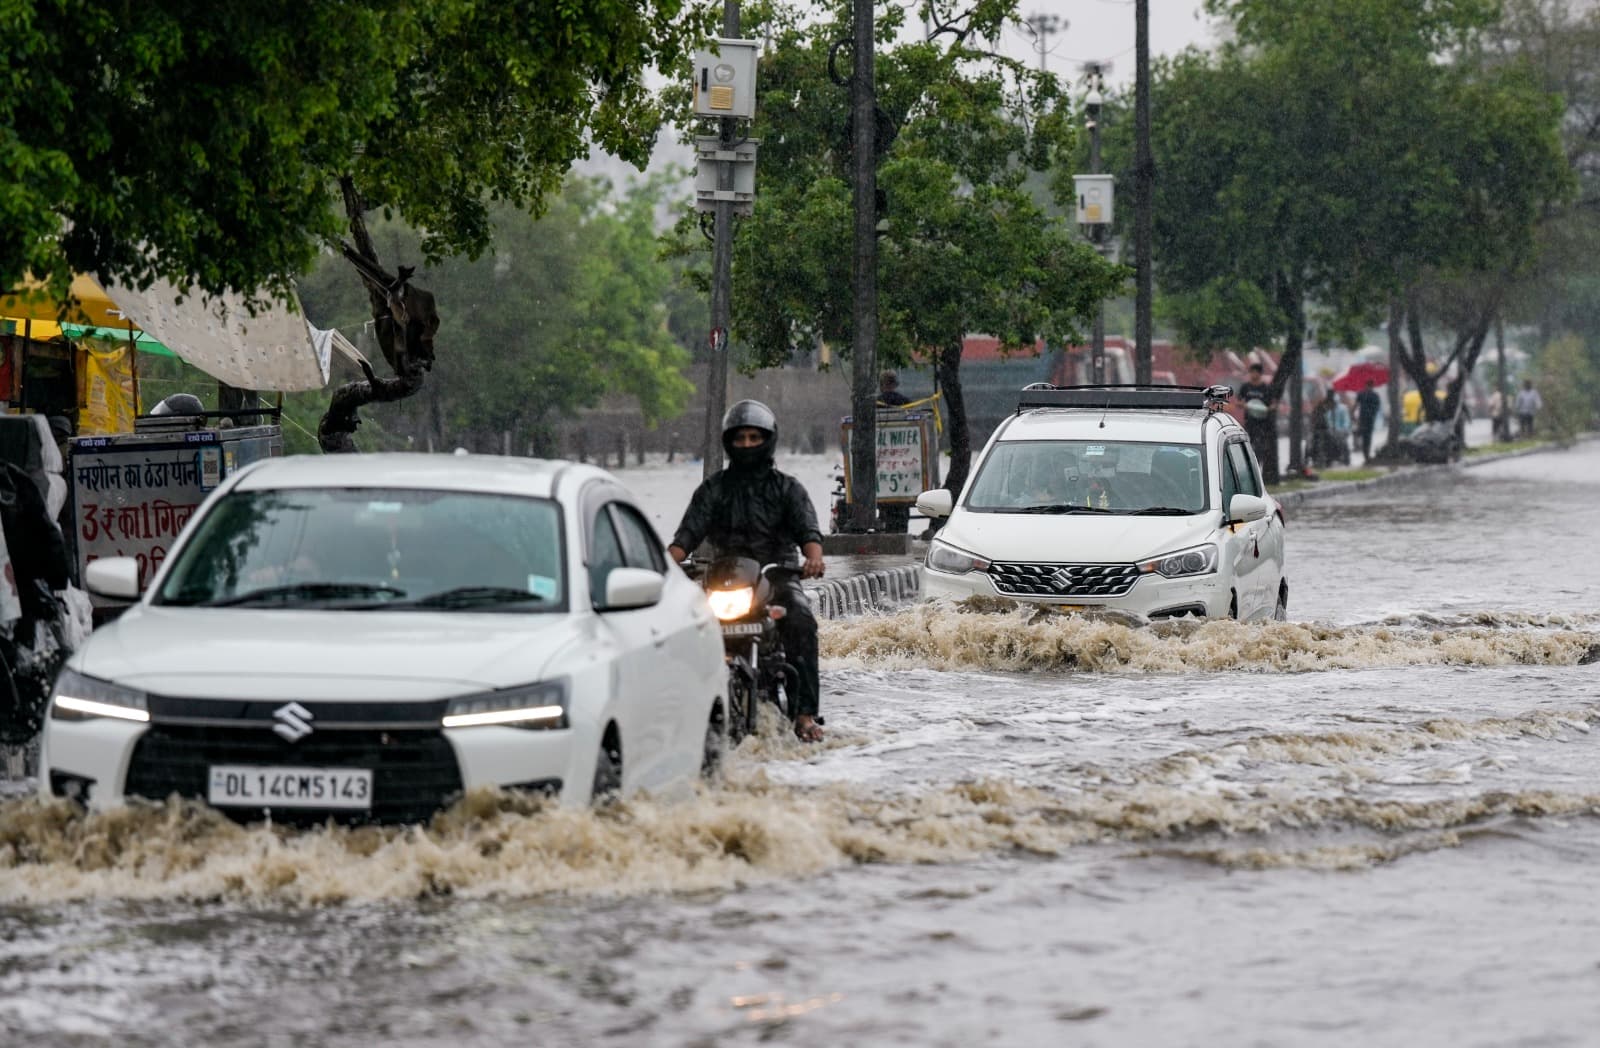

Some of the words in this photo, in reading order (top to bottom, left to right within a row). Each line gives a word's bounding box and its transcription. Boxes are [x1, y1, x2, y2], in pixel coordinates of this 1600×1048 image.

[124, 464, 141, 489] का
[144, 459, 168, 487] ठंडा
[225, 772, 369, 799] DL14CM5143
